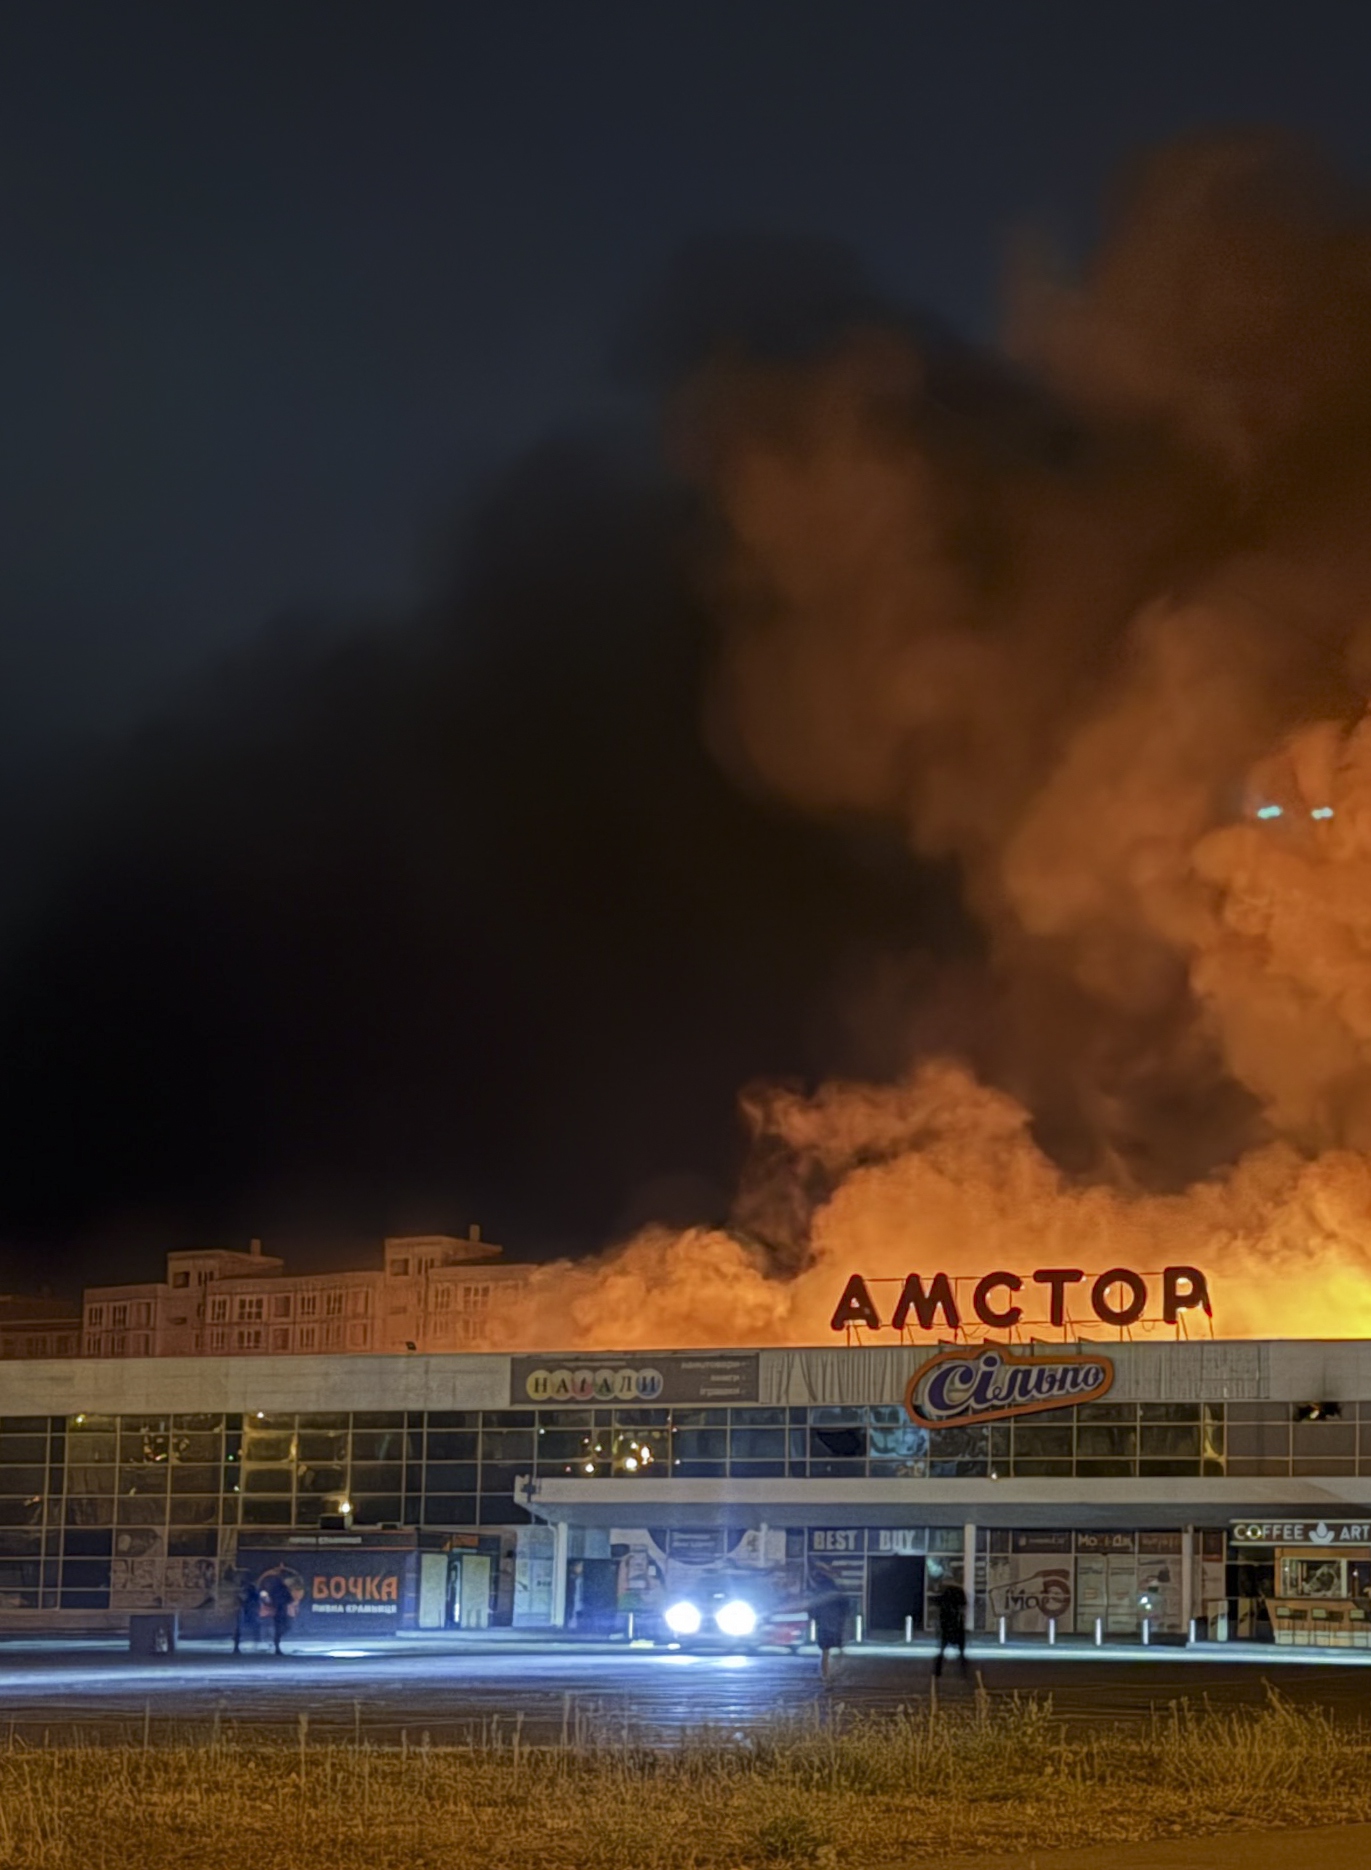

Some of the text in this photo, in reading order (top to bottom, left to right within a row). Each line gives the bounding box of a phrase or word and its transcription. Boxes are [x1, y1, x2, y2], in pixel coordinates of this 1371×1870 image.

[831, 1267, 1212, 1330] АМСТОР
[926, 1353, 1104, 1414] Сільпо
[813, 1529, 858, 1550] BEST
[879, 1529, 916, 1550] BUY
[1233, 1524, 1371, 1541] COFFEE ART
[312, 1575, 398, 1601] БОЧКА
